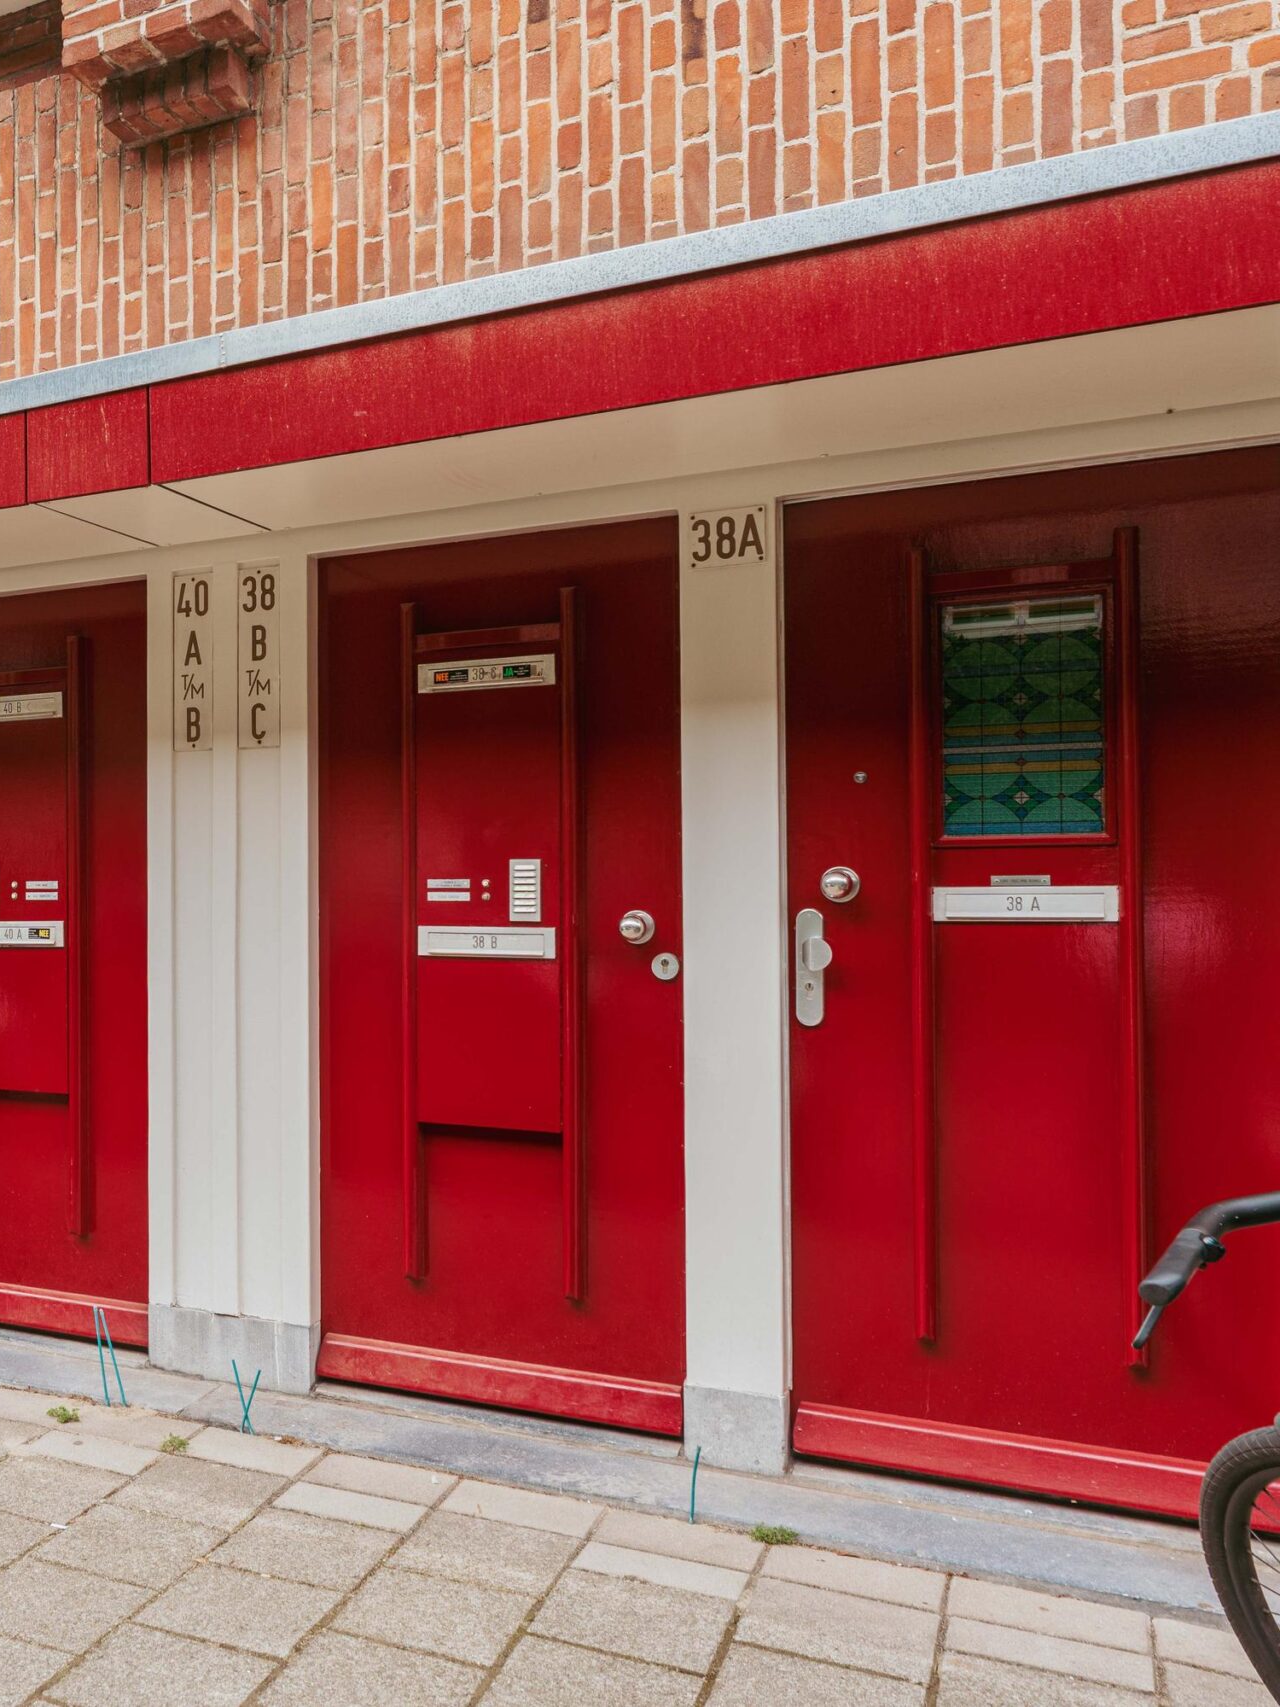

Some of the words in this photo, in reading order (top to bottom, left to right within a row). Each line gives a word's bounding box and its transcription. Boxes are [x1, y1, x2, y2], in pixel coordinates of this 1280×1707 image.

[691, 513, 763, 563] 38A
[176, 579, 209, 617] 40
[242, 573, 276, 613] 38
[184, 630, 202, 666] A
[251, 624, 267, 662] B
[245, 669, 271, 697] T/M
[435, 672, 449, 683] NEE
[504, 667, 513, 677] JA
[181, 673, 205, 701] T/M
[3, 702, 13, 714] 40
[16, 701, 22, 713] B
[251, 702, 266, 740] C
[186, 706, 201, 743] B
[1006, 896, 1023, 912] 38
[1030, 896, 1040, 911] A
[4, 928, 14, 939] 40
[17, 928, 23, 940] A
[38, 929, 49, 938] NEE
[472, 935, 485, 949] 38
[491, 935, 498, 949] B
